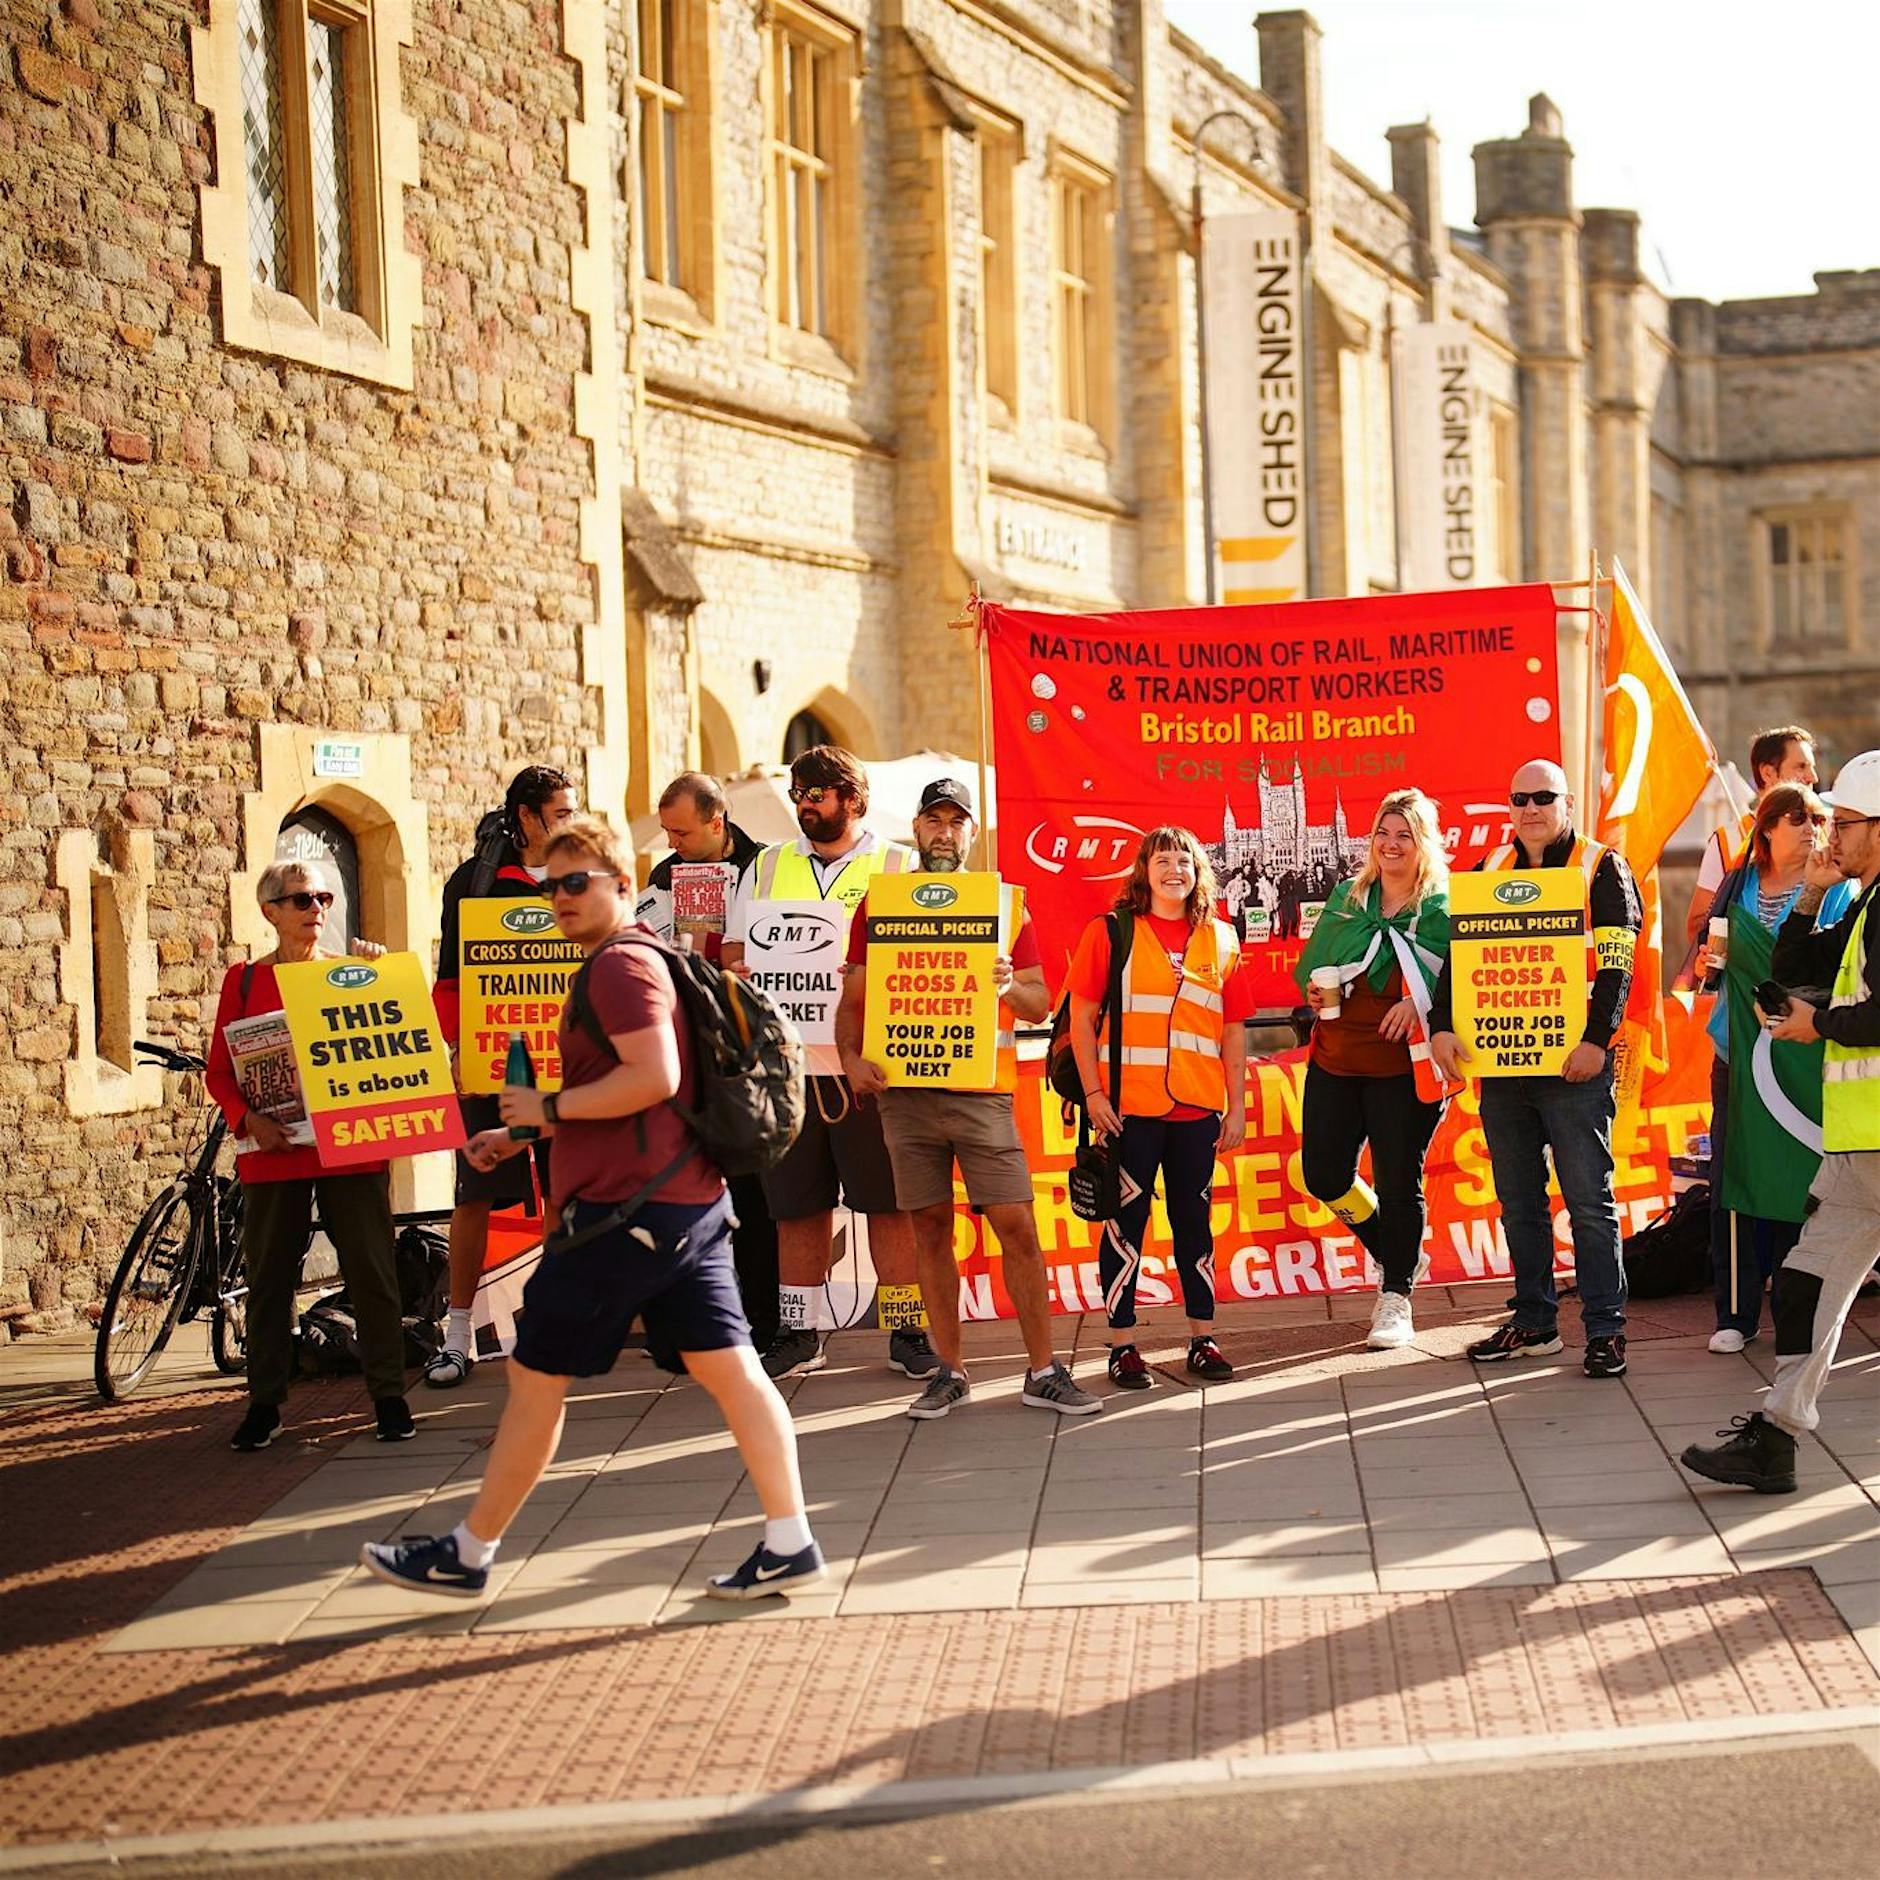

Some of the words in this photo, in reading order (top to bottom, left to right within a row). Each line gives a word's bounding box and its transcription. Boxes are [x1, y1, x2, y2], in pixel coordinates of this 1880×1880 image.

[1028, 632, 1170, 669] NATIONAL
[1179, 643, 1269, 669] UNION
[1270, 640, 1305, 667] OF
[1313, 637, 1380, 665] RAIL,
[1389, 626, 1515, 660] MARITIME
[1107, 674, 1126, 702] &
[1135, 675, 1301, 704] TRANSPORT
[1310, 667, 1445, 702] WORKERS
[1140, 712, 1241, 744] Bristol
[1250, 710, 1304, 744] Rail
[1312, 705, 1416, 741] Branch
[1446, 823, 1516, 848] RMT
[1052, 836, 1129, 860] RMT
[674, 881, 724, 894] SUPPORT
[921, 890, 949, 900] RMT
[1504, 887, 1532, 897] RMT
[514, 914, 548, 924] RMT
[1458, 918, 1523, 933] OFFICIAL
[1527, 916, 1578, 931] PICKET
[767, 926, 821, 941] RMT
[874, 922, 939, 936] OFFICIAL
[942, 923, 992, 936] PICKET
[470, 944, 516, 960] CROSS
[521, 942, 587, 959] COUNTR
[897, 951, 968, 969] NEVER
[1482, 945, 1554, 964] NEVER
[1267, 950, 1299, 973] TH
[1603, 956, 1633, 971] PICKE
[338, 970, 367, 982] RMT
[885, 974, 955, 992] CROSS
[962, 975, 978, 992] A
[1471, 968, 1543, 986] CROSS
[1550, 967, 1567, 983] A
[889, 997, 972, 1016] PICKET!
[1476, 989, 1561, 1008] PICKET!
[321, 1000, 403, 1031] THIS
[780, 1003, 827, 1021] CKET
[885, 1024, 934, 1039] YOUR
[940, 1025, 974, 1039] JOB
[1474, 1016, 1524, 1031] YOUR
[1530, 1016, 1565, 1029] JOB
[309, 1028, 432, 1067] STRIKE
[885, 1043, 945, 1058] COULD
[952, 1044, 973, 1058] BE
[1475, 1034, 1536, 1049] COULD
[1543, 1034, 1565, 1047] BE
[244, 1051, 290, 1081] STRIKE
[1497, 1052, 1542, 1066] NEXT
[490, 1058, 562, 1080] SFE
[906, 1063, 951, 1077] NEXT
[241, 1080, 256, 1096] TO
[260, 1067, 297, 1092] BEAT
[327, 1079, 350, 1097] is
[358, 1069, 429, 1094] about
[331, 1108, 446, 1147] SAFETY
[959, 1272, 1000, 1322] N
[884, 1314, 921, 1328] PICKET
